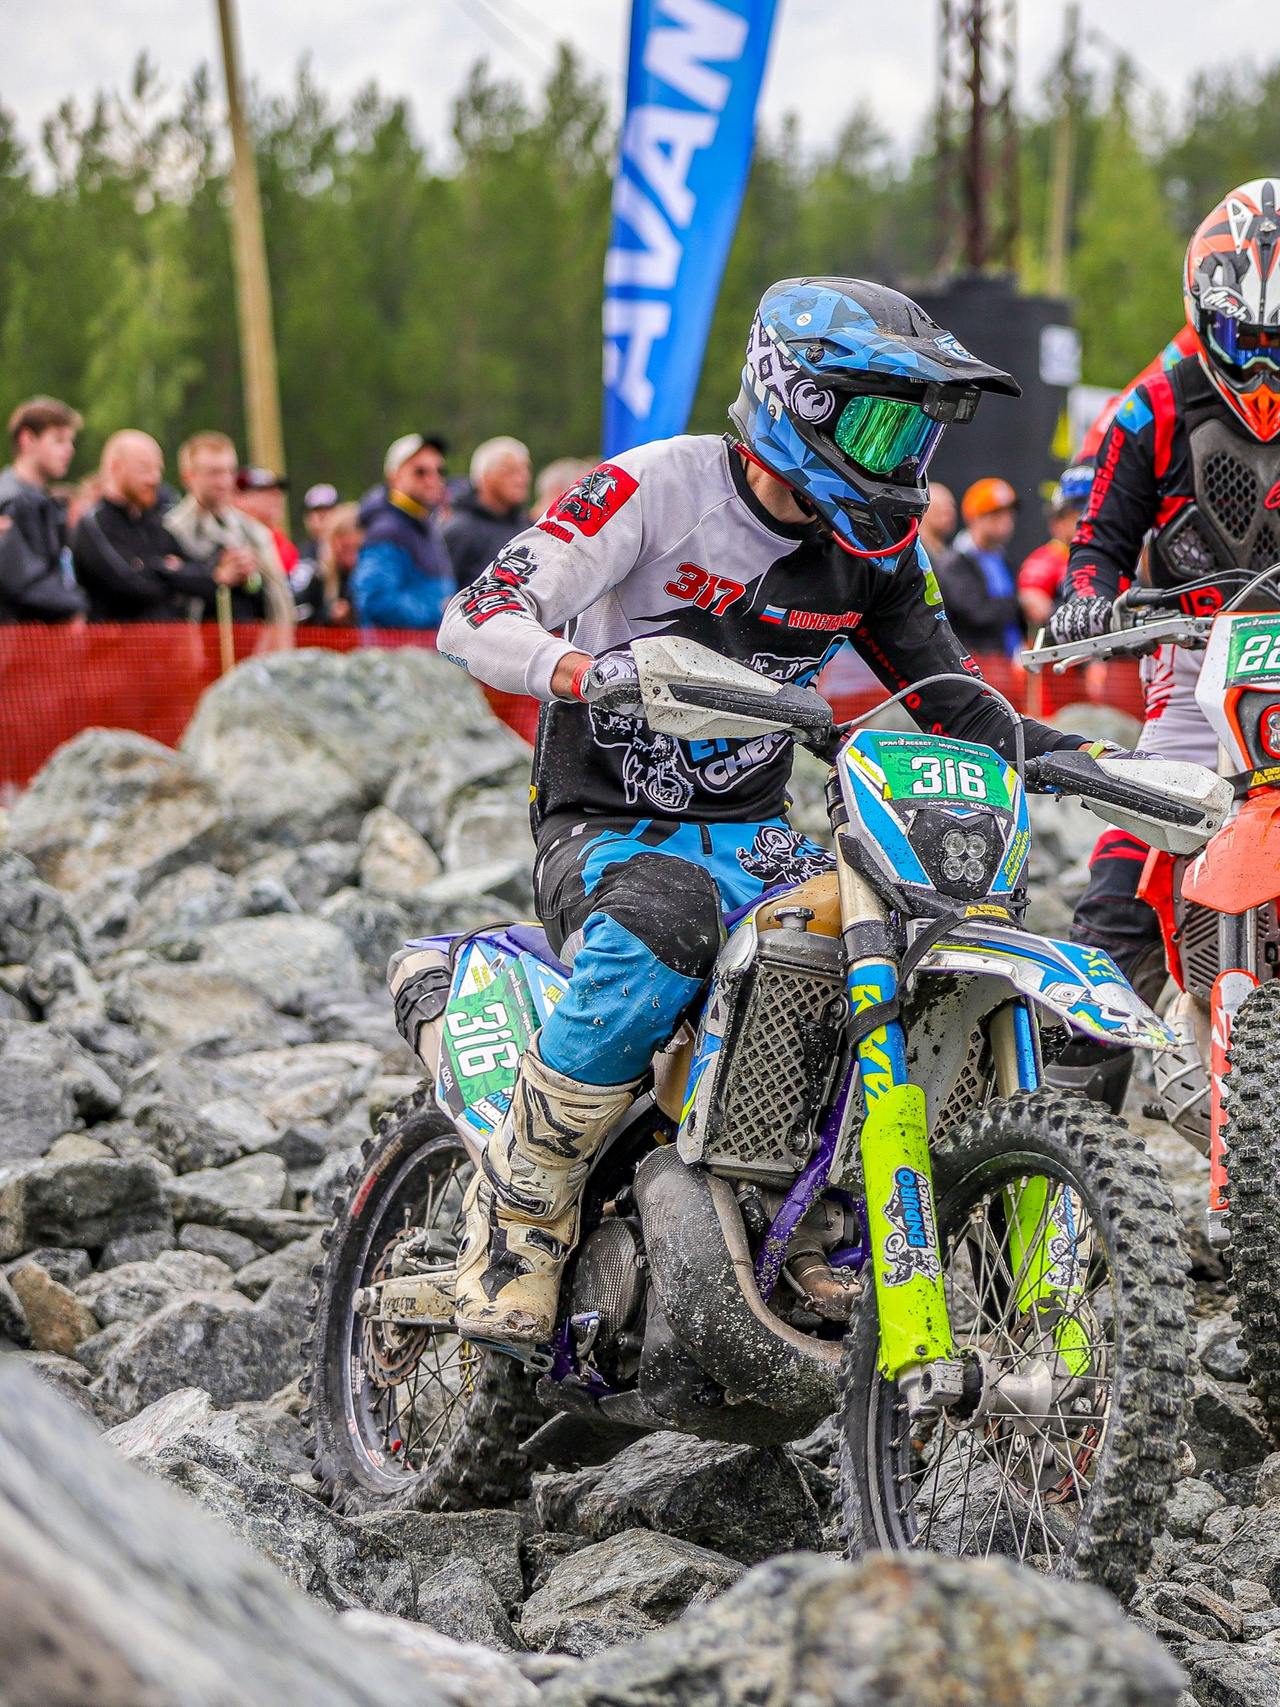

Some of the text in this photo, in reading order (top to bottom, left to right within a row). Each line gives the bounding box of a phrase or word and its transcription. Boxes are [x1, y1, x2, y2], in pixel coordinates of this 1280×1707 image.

[663, 562, 747, 616] 317
[910, 755, 987, 800] 316
[969, 802, 993, 813] KODA
[446, 1001, 521, 1079] 316
[441, 1065, 454, 1092] KODA
[897, 1169, 928, 1247] ENDURO
